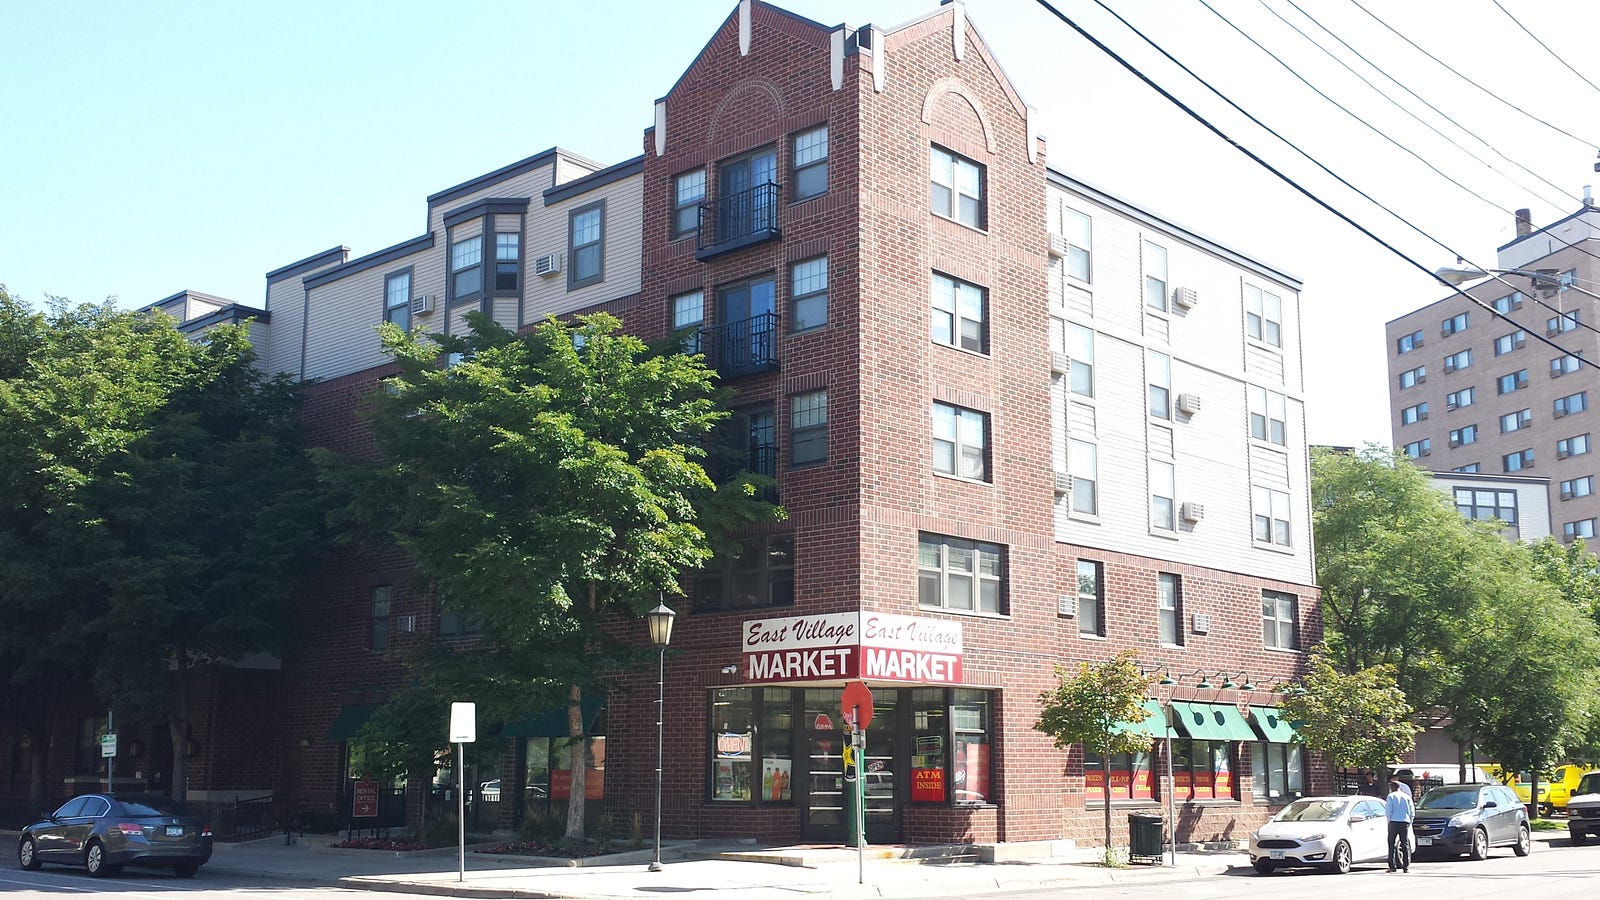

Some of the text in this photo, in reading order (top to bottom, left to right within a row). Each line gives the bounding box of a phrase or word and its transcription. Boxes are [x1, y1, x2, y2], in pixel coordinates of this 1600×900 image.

[746, 619, 855, 646] East Village
[865, 616, 959, 650] East Village
[748, 648, 852, 680] MARKET
[866, 648, 958, 681] MARKET
[867, 760, 884, 773] OPEN
[916, 770, 942, 779] ATM
[916, 781, 942, 790] INSIDE
